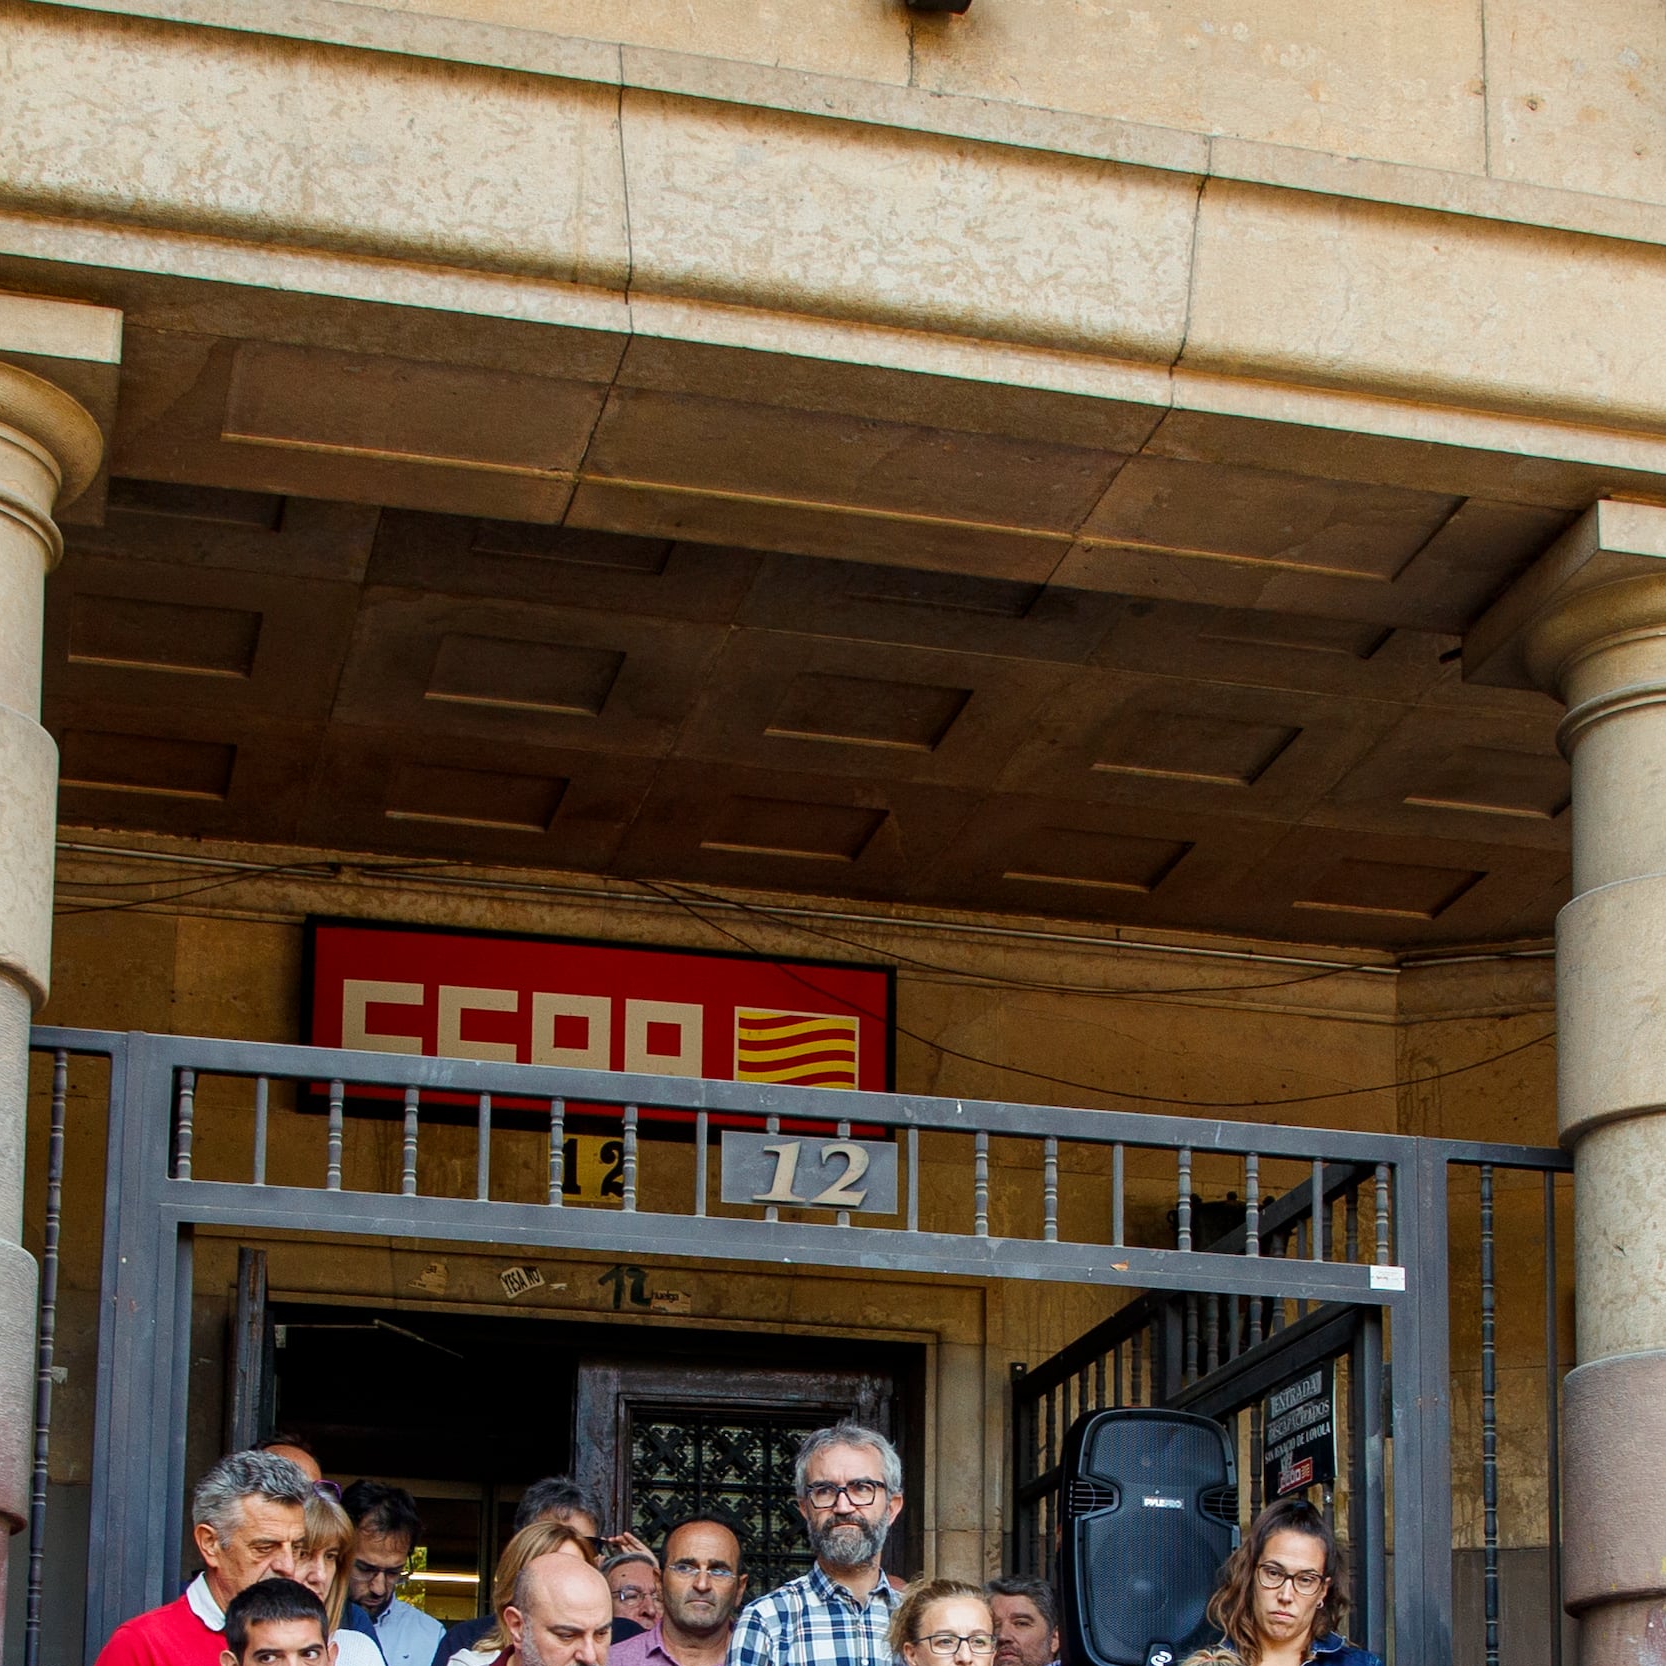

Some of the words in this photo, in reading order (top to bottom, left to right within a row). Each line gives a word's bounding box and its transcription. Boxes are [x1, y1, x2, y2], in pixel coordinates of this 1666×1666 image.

[342, 978, 704, 1078] CCOO
[562, 1138, 625, 1197] 12
[752, 1141, 870, 1207] 12
[1274, 1373, 1320, 1413] ENTRADA
